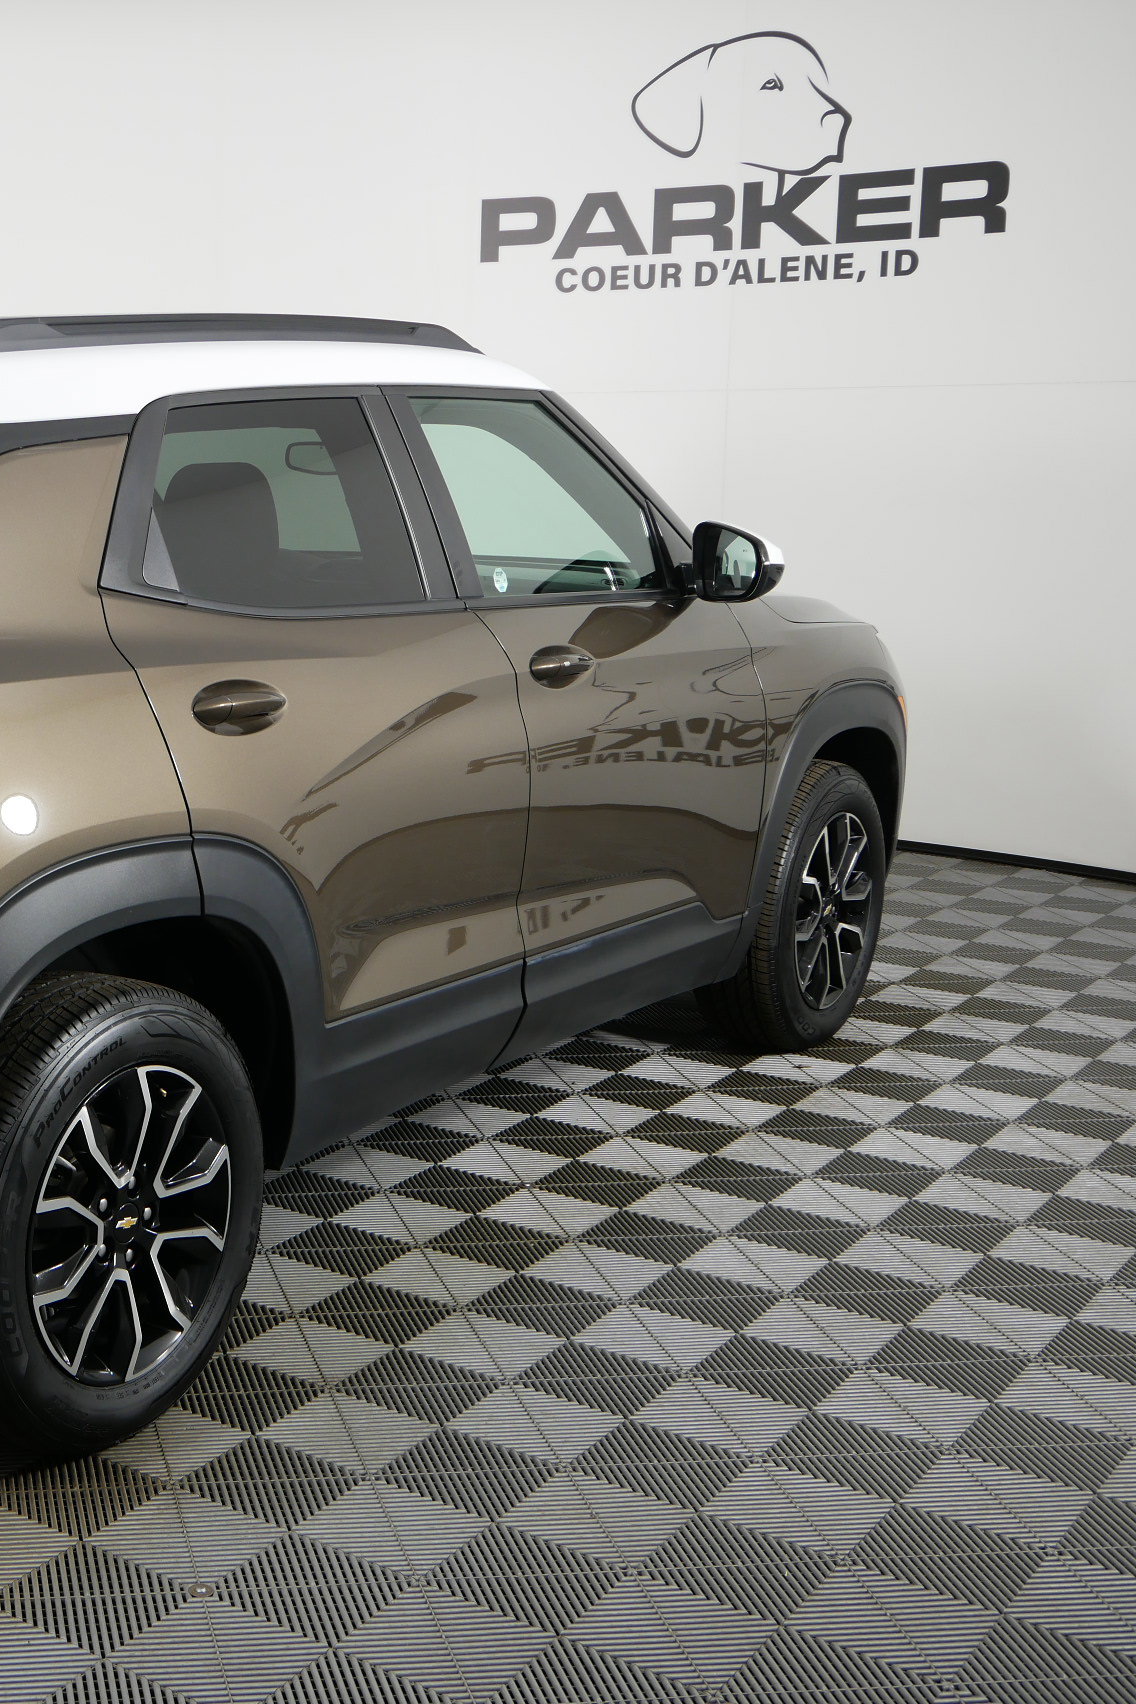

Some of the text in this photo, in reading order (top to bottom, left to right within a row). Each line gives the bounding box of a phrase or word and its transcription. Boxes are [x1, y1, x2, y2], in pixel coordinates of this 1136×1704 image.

[480, 161, 1010, 263] PARKER
[554, 248, 920, 293] COEUR D'ALENE, ID
